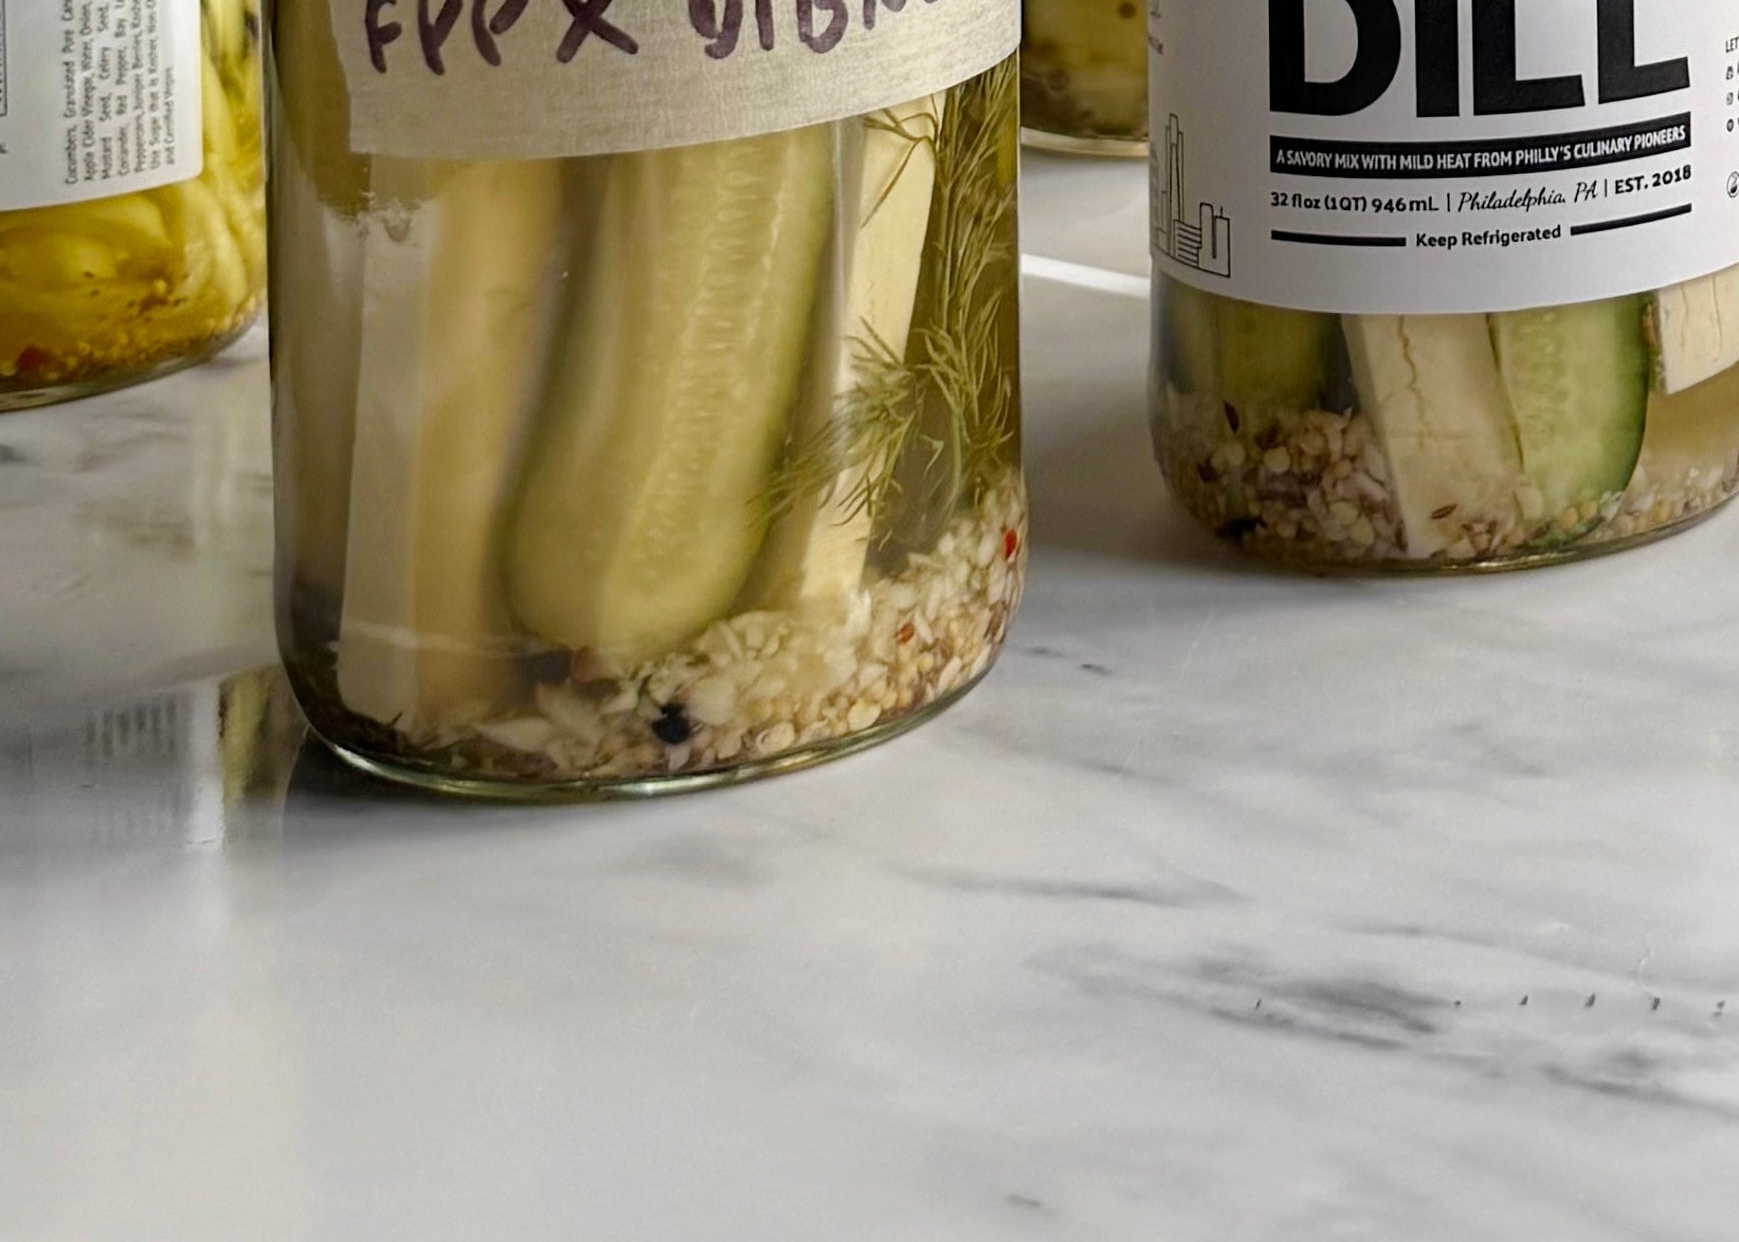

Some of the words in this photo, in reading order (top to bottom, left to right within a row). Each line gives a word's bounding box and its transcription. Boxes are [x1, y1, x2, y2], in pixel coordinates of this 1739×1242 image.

[82, 120, 94, 147] Cider
[1277, 149, 1285, 165] A
[1286, 150, 1333, 169] SAVORY
[1335, 153, 1359, 170] MIX
[1361, 154, 1397, 170] WITH
[1400, 154, 1434, 170] MILD
[1437, 152, 1470, 170] HEAT
[1474, 151, 1512, 169] FROM
[1515, 144, 1572, 166] PHILLY'S
[1573, 137, 1633, 159] CULINARY
[1634, 124, 1686, 151] PIONEERS
[1271, 192, 1288, 208] 32
[1324, 194, 1368, 213] (1QT)
[1574, 179, 1599, 203] PA
[1615, 175, 1649, 195] EST.
[1652, 164, 1692, 188] 2018
[1416, 232, 1458, 250] Keep
[1462, 224, 1562, 248] Refrigerated
